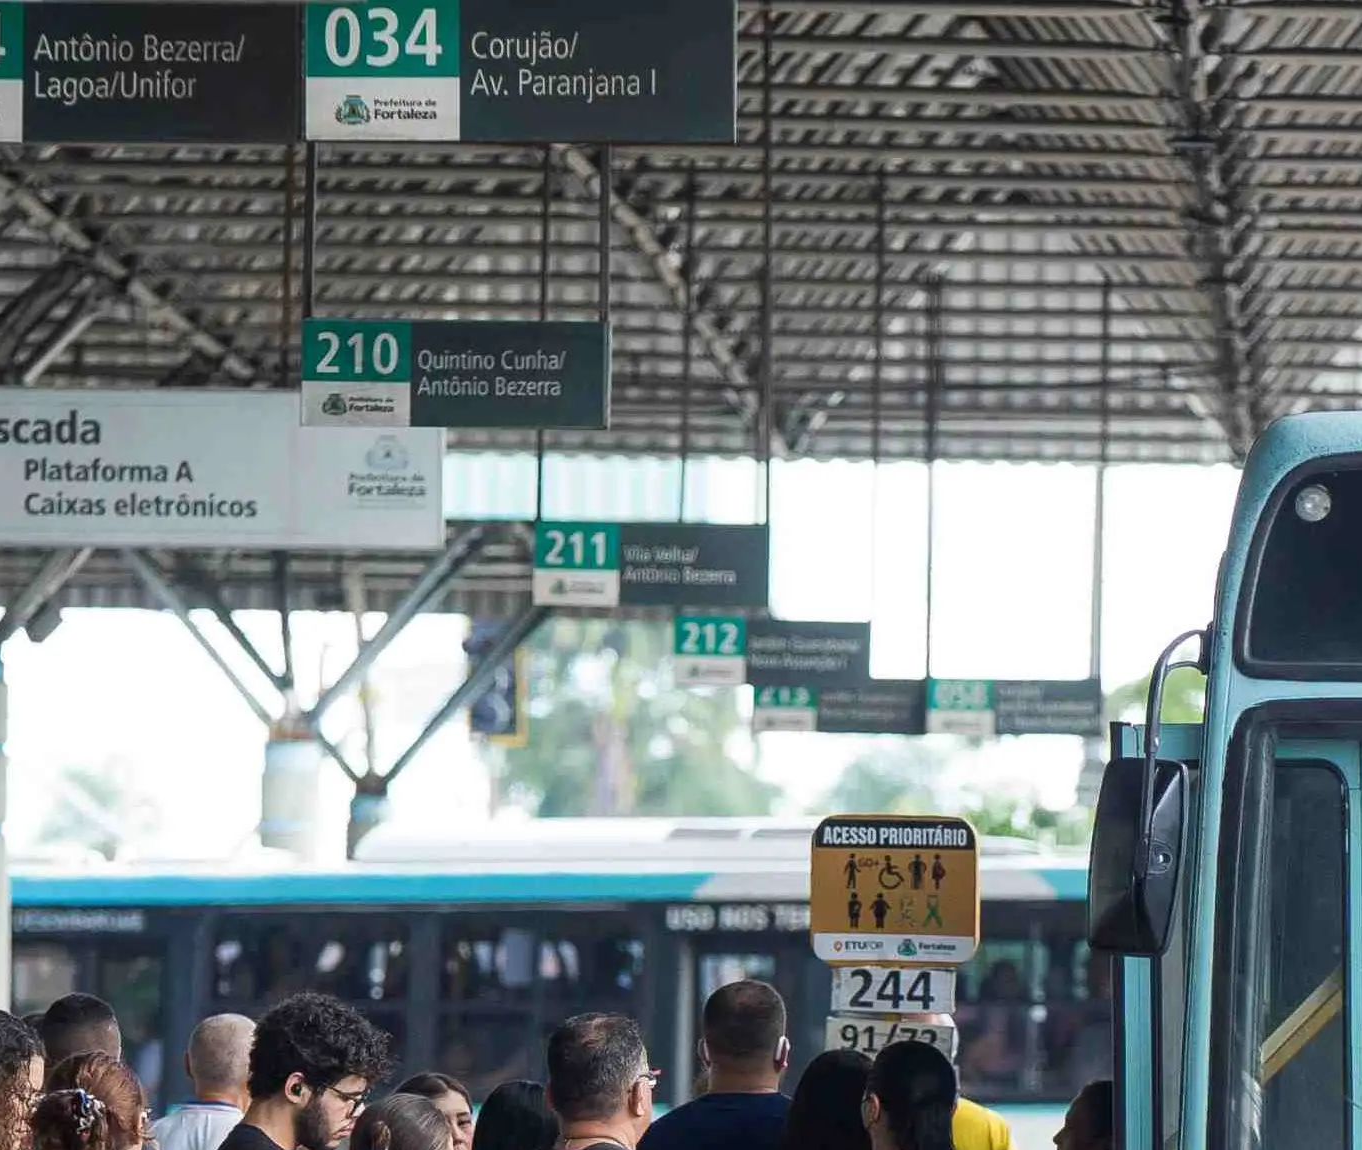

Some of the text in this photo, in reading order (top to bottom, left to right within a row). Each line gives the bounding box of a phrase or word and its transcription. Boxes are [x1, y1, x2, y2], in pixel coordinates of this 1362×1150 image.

[34, 33, 245, 63] Antônio Bezerra/
[324, 8, 443, 68] 034
[471, 31, 579, 66] Corujão/
[34, 71, 197, 105] Lagoa/Unifor
[470, 70, 508, 96] Av.
[518, 69, 641, 103] Paranjana
[374, 108, 437, 120] Fortaleza
[316, 332, 399, 374] 210
[417, 350, 567, 372] Quintino Cunha/
[417, 375, 562, 396] Antônio Bezerra
[24, 458, 194, 483] Plataforma A
[24, 492, 257, 518] Caixas eletrônicos
[544, 531, 607, 566] 211
[682, 622, 738, 654] 212
[823, 824, 968, 847] ACESSO PRIORITÁRIO
[844, 940, 885, 951] ETUFOR
[849, 969, 935, 1010] 244
